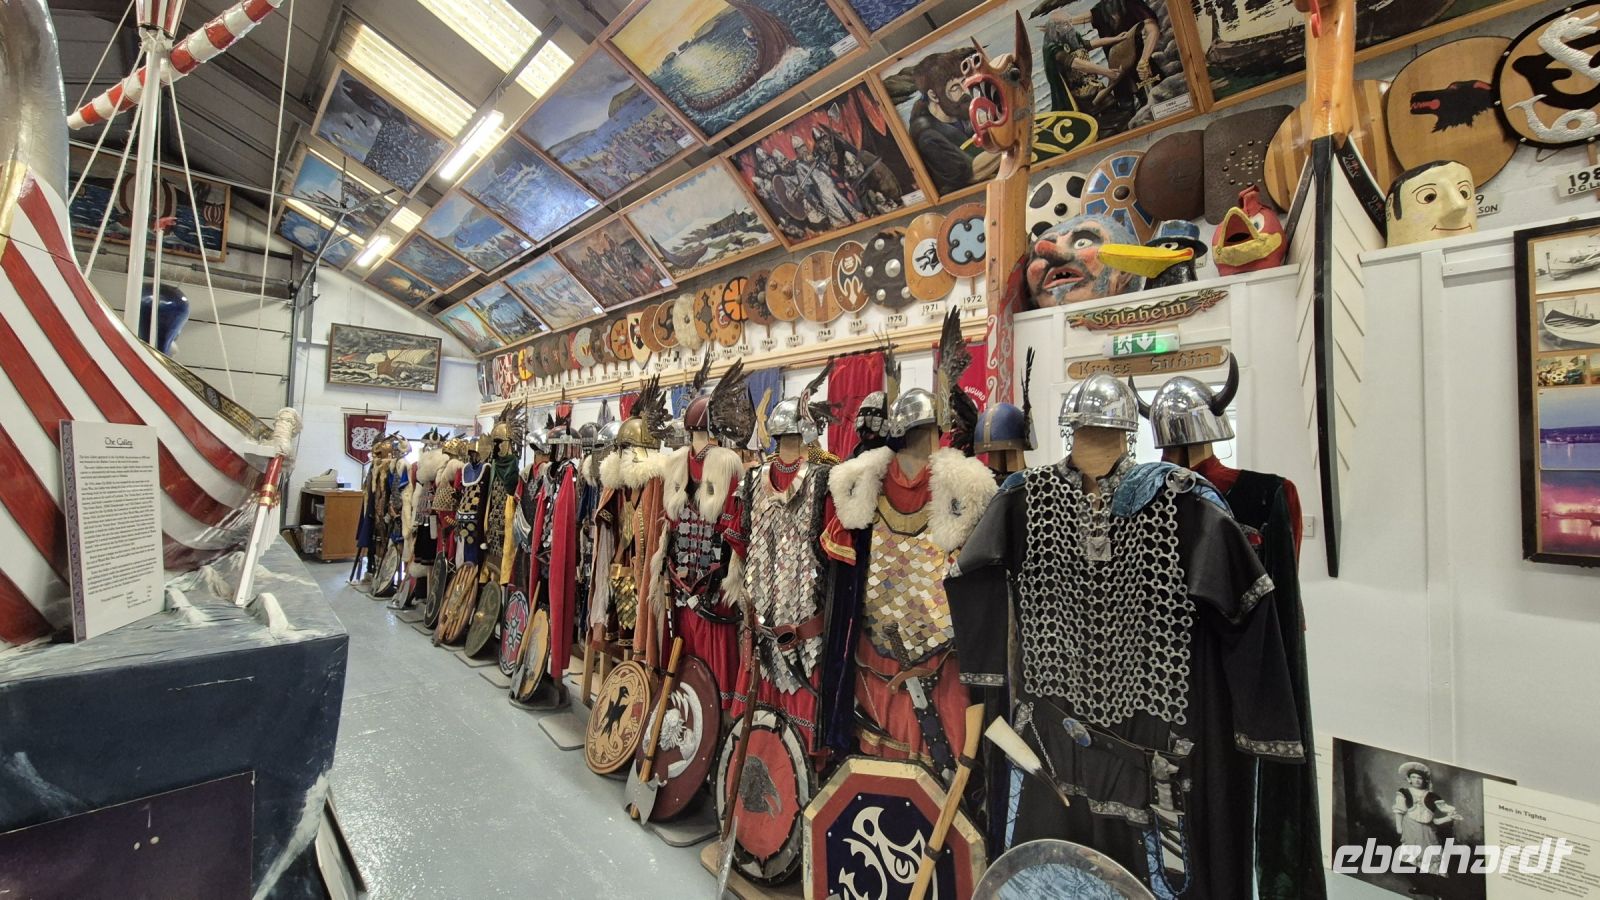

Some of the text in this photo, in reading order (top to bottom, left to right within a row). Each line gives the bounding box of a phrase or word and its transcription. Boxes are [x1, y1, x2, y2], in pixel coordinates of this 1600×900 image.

[963, 295, 982, 304] 1972
[922, 305, 938, 313] 1971
[887, 315, 903, 323] 1970
[1498, 804, 1514, 814] Men
[1524, 810, 1547, 822] Tights
